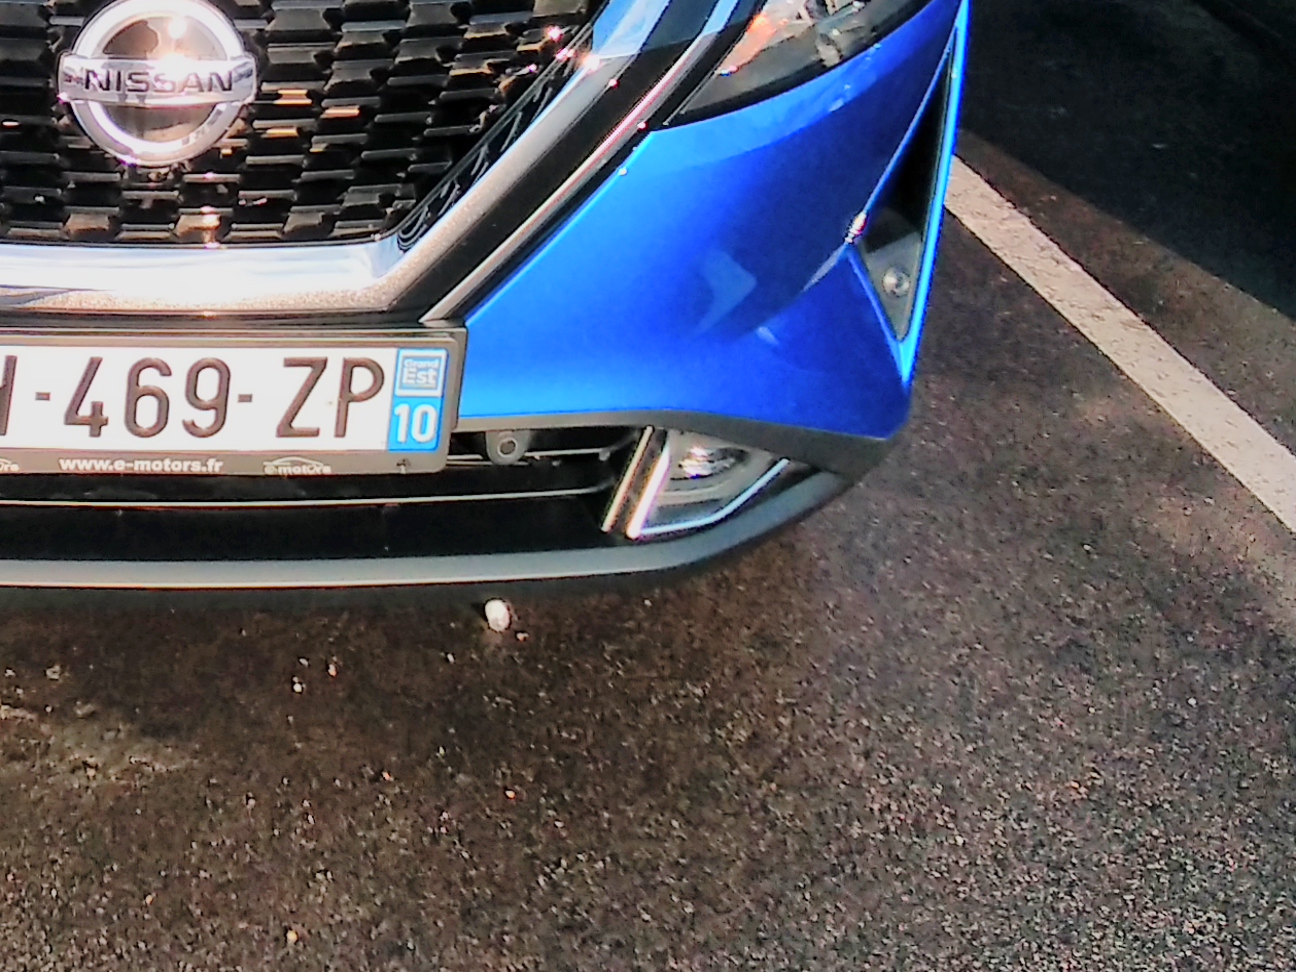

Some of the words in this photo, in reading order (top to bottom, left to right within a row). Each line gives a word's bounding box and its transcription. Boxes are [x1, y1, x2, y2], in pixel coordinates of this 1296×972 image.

[83, 69, 233, 94] NISSAN
[404, 359, 440, 369] Grand
[402, 368, 438, 385] Est
[393, 403, 438, 444] 10
[58, 457, 224, 473] www.e-motors.fr
